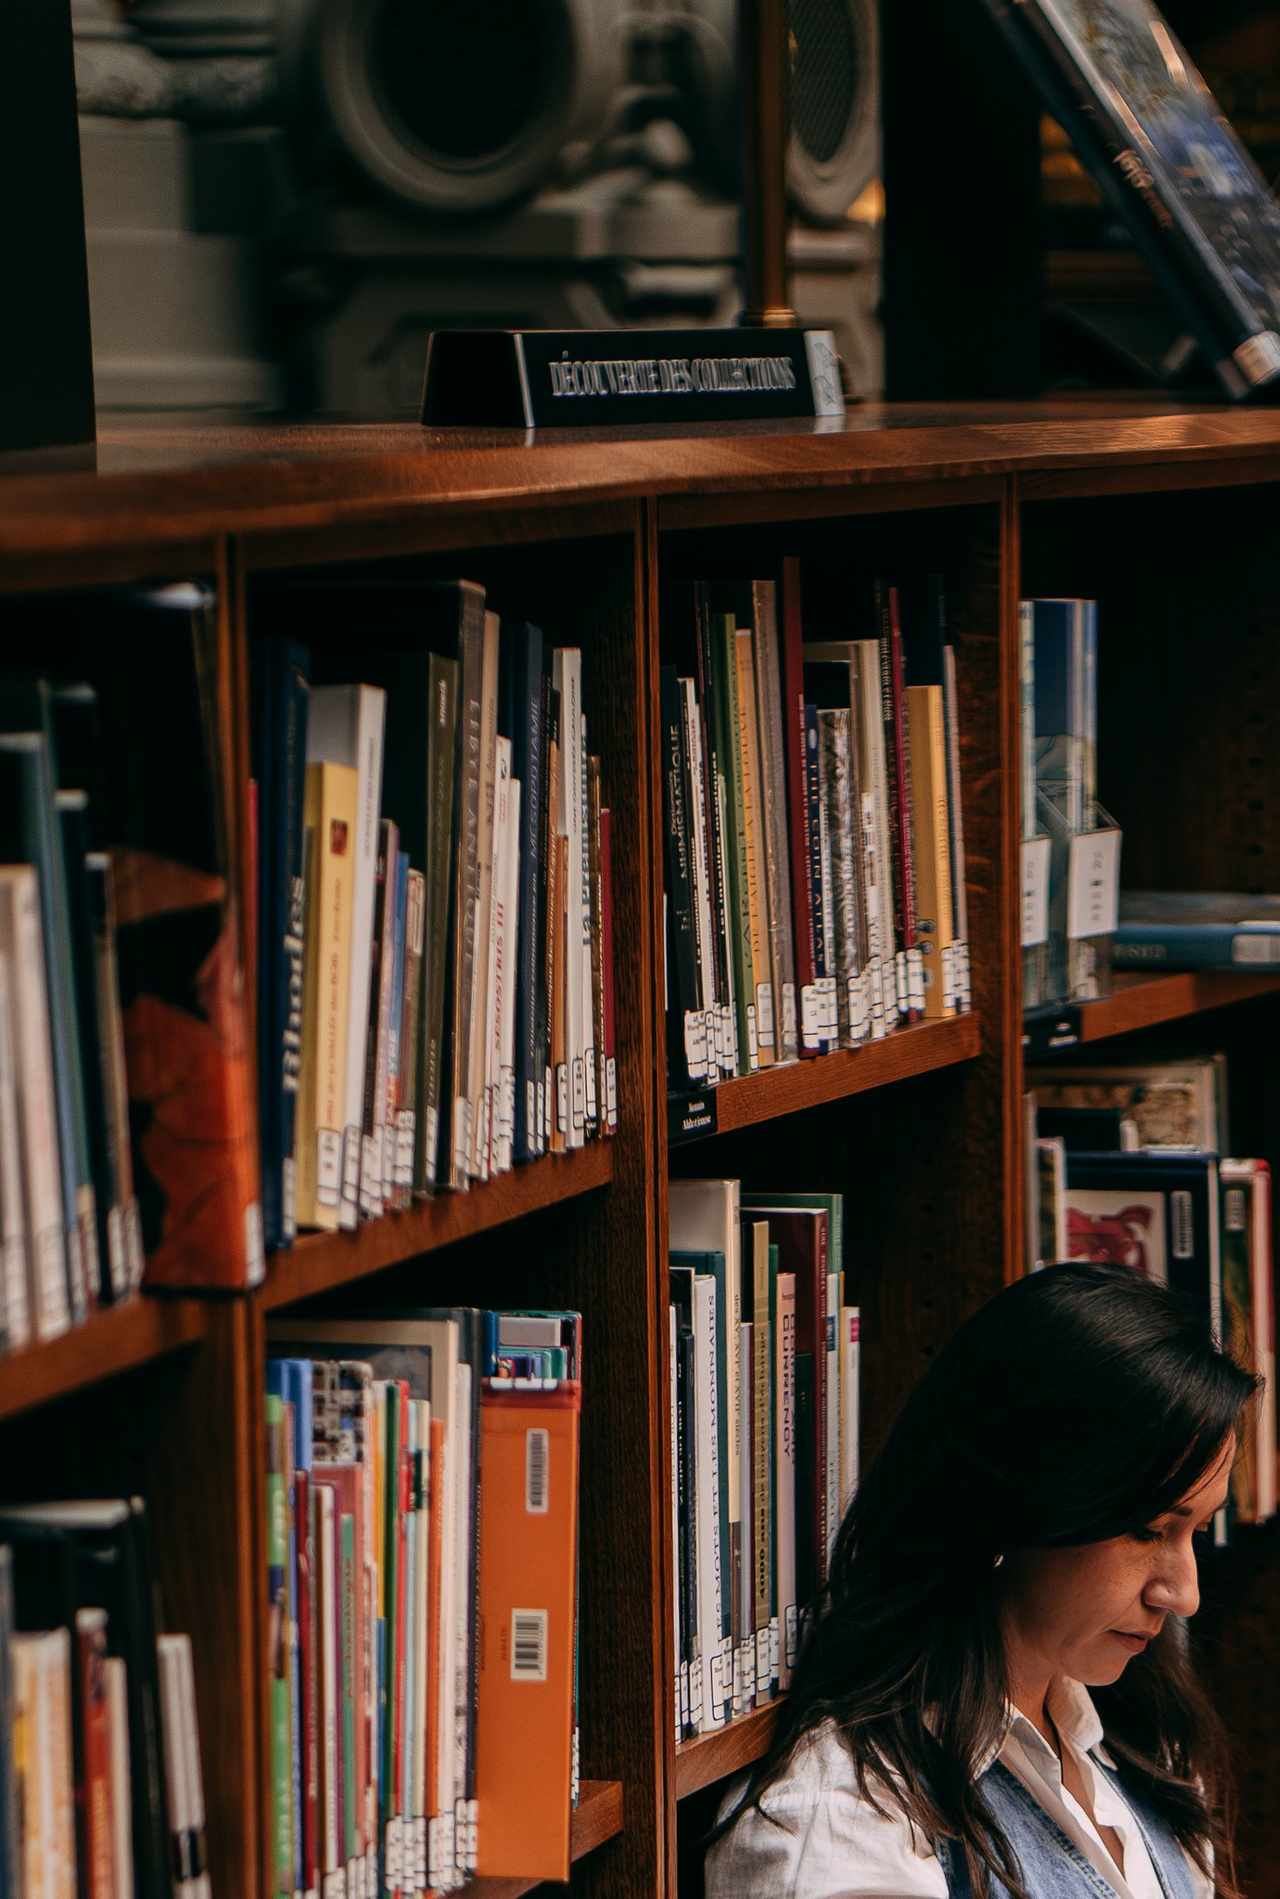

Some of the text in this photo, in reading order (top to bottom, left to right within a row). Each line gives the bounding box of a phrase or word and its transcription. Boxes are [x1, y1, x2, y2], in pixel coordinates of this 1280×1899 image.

[548, 349, 796, 397] DÉCOUVERTE DES COLLECTIONS
[528, 693, 539, 859] MÉSOPOTAMIE
[669, 724, 688, 880] NUMISMATIQUE
[809, 760, 824, 963] THE COIN ATLAS
[281, 875, 305, 1093] Rhodes
[707, 1294, 717, 1428] MONNAIES
[758, 1330, 766, 1414] d'échange
[782, 1313, 790, 1459] CURRENCY
[710, 1434, 718, 1479] LES
[759, 1417, 767, 1480] moyens
[713, 1530, 721, 1596] MOTS
[714, 1600, 723, 1645] LES
